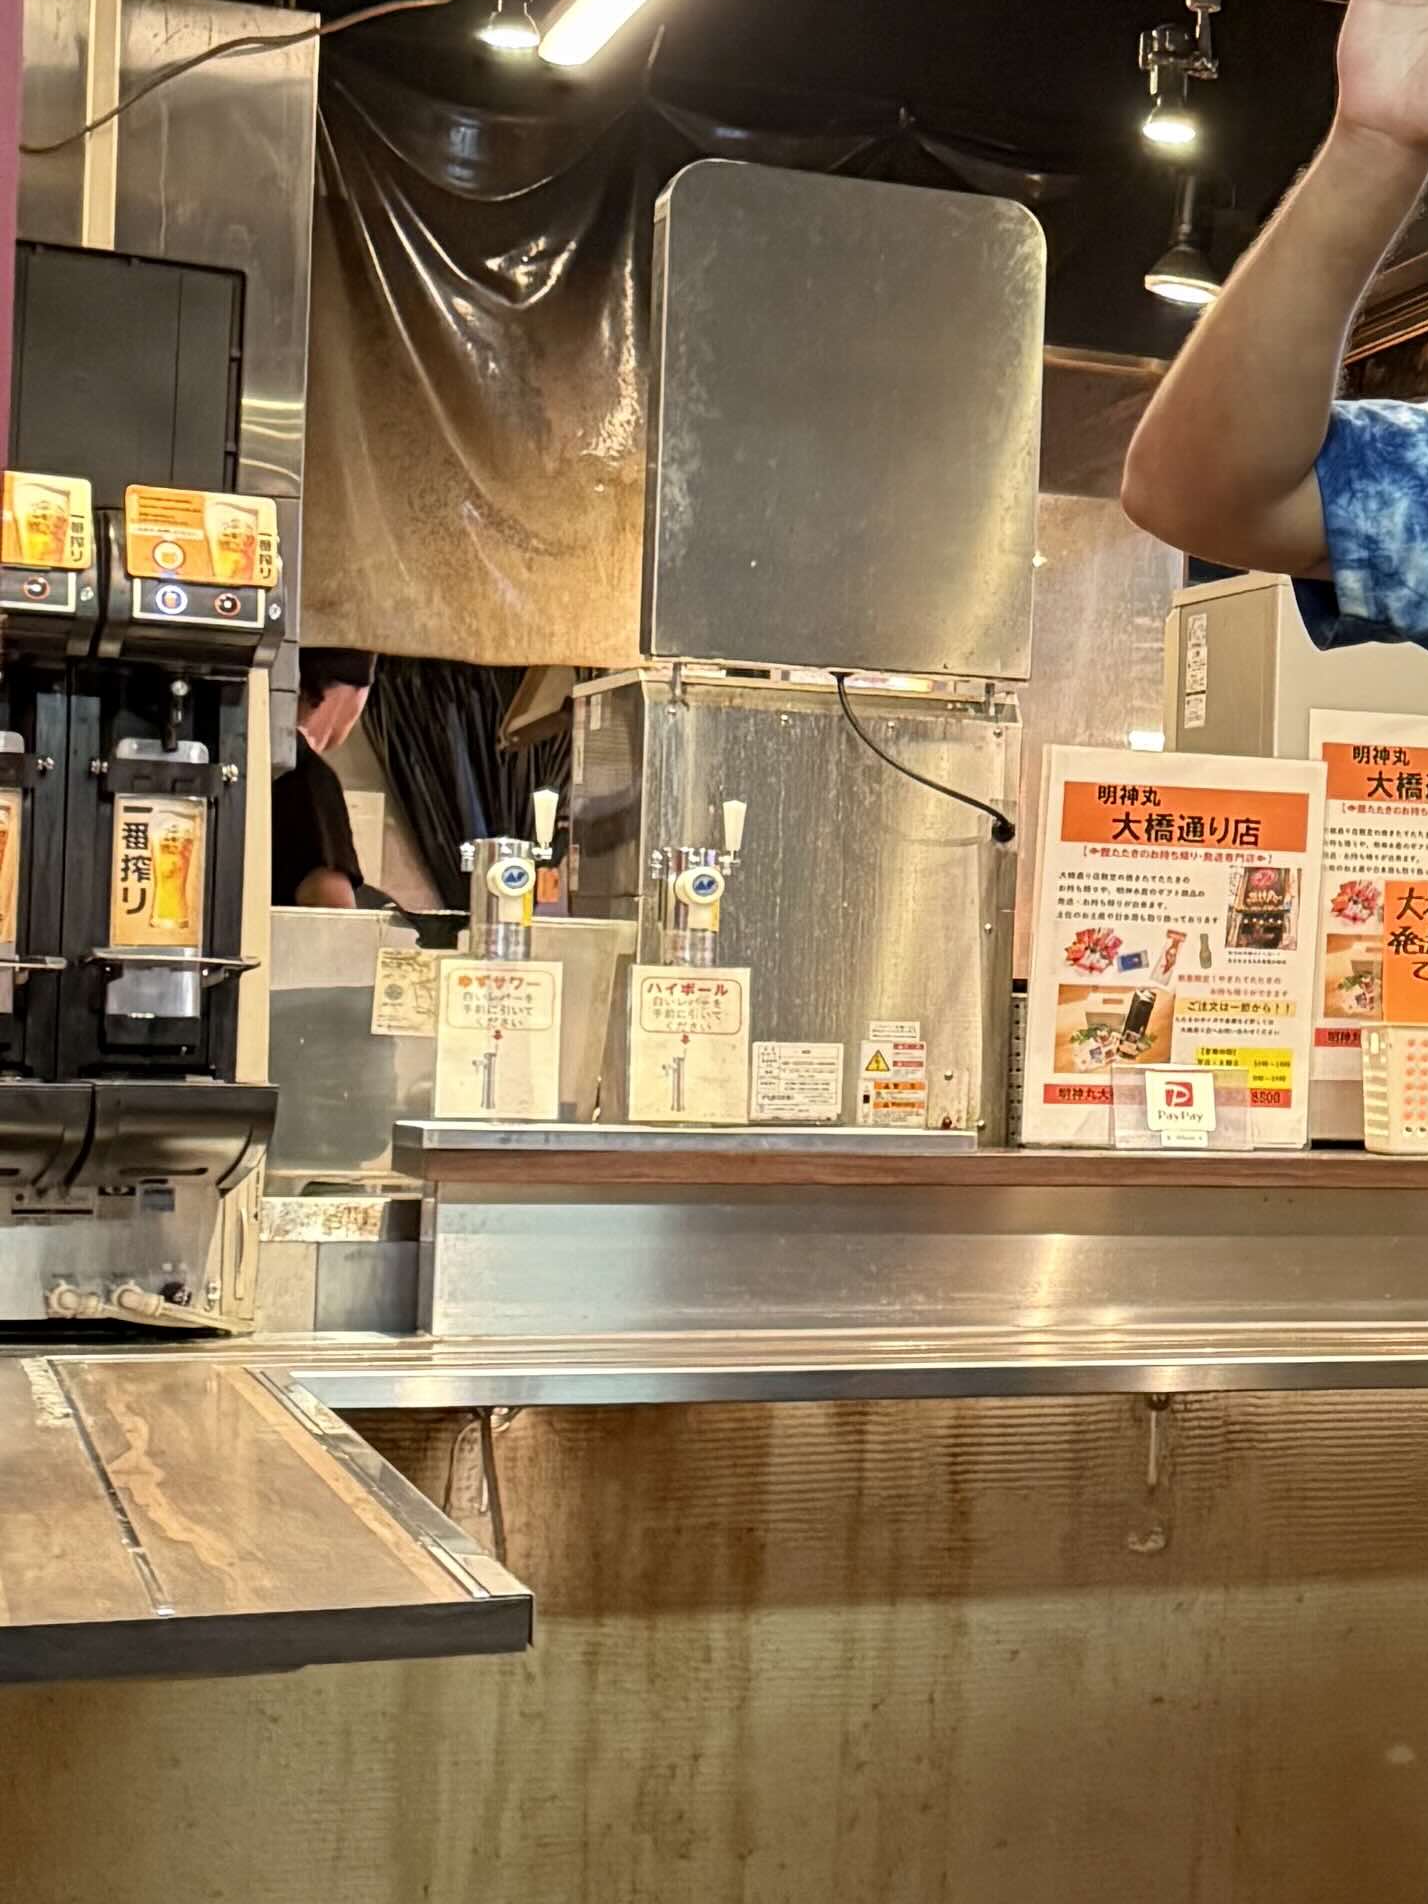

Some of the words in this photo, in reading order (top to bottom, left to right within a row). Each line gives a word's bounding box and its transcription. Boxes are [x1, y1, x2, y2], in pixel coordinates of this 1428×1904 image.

[70, 513, 86, 563] 一番搾り
[259, 532, 274, 581] 一番搾り
[1352, 744, 1411, 767] 明神丸
[1097, 784, 1161, 807] 明神丸
[1112, 811, 1261, 848] 大橋通り店
[120, 805, 153, 915] 一番搾り
[458, 974, 541, 990] ゆずサワー
[647, 982, 728, 997] ハイボール
[1058, 1087, 1114, 1103] 明神丸大
[1158, 1109, 1204, 1123] PayPay
